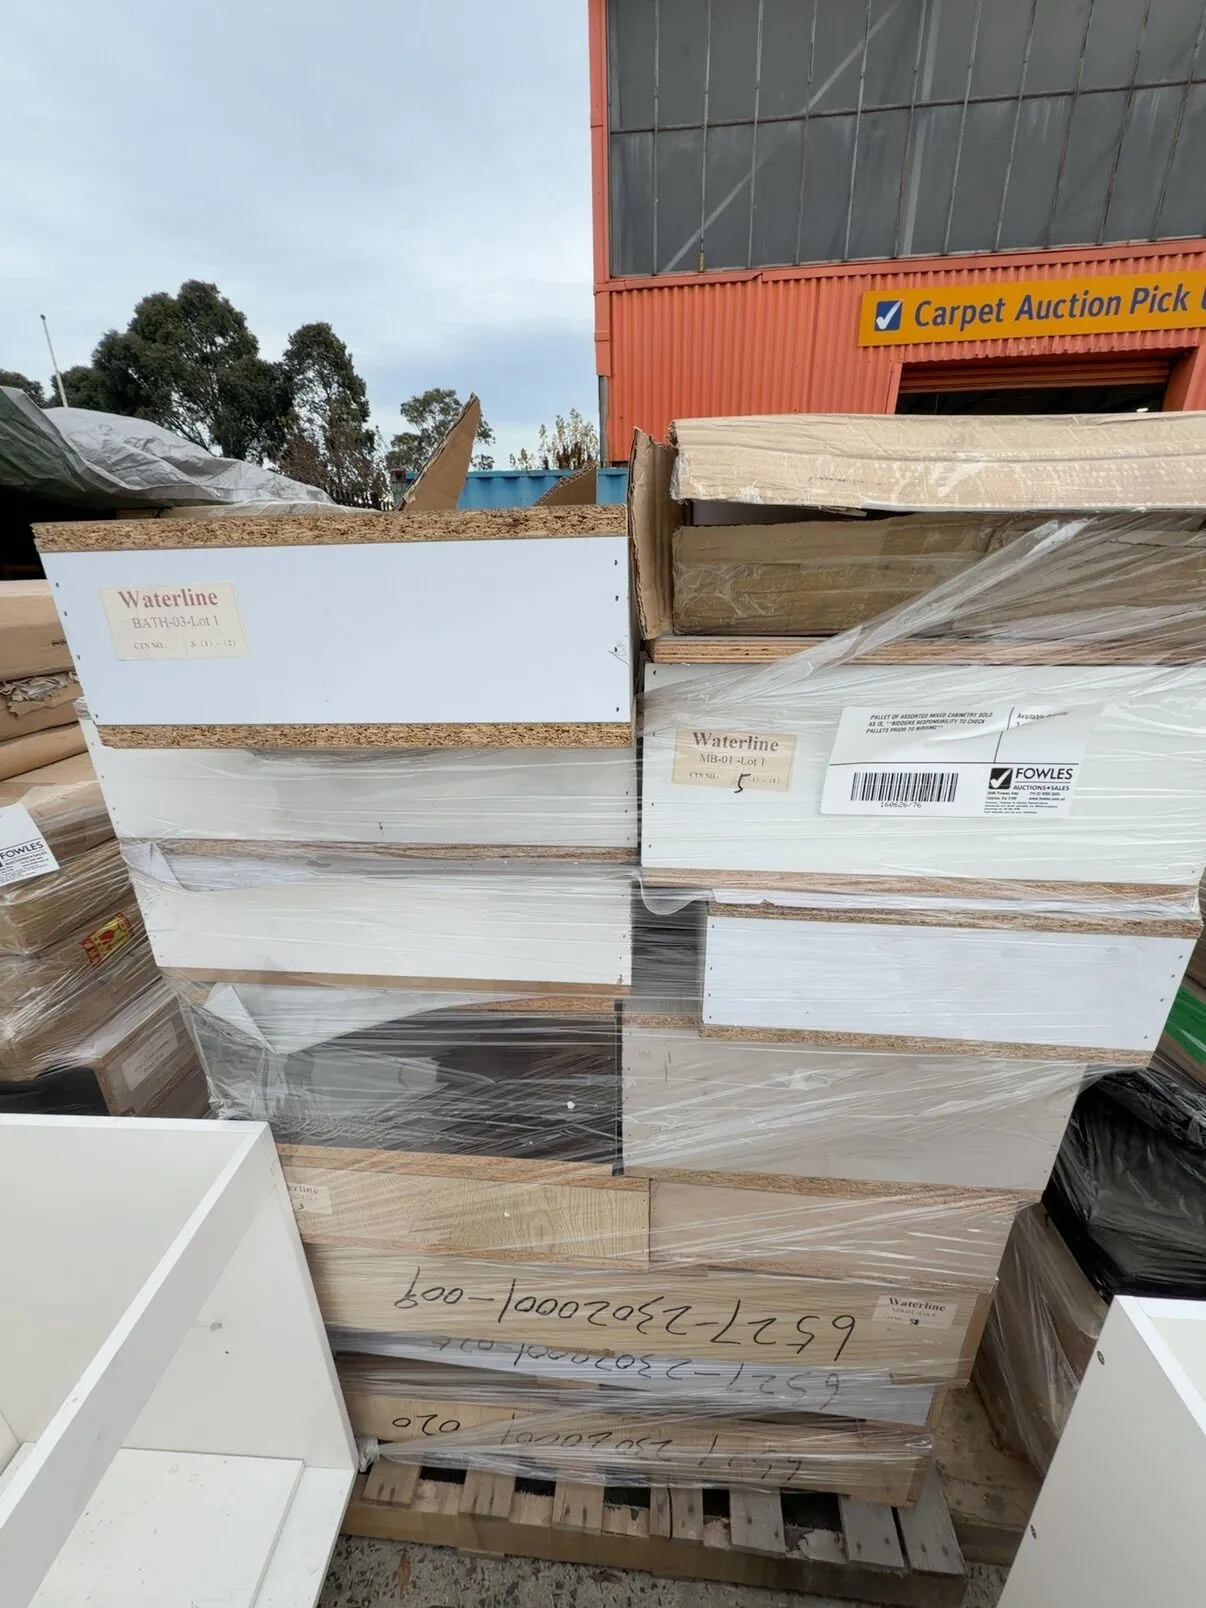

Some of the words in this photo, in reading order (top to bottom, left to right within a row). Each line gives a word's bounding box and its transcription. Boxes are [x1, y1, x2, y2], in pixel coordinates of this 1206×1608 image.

[914, 298, 1006, 332] Carpet
[1014, 290, 1122, 321] Auction
[1129, 283, 1191, 314] Pick
[118, 588, 218, 609] Waterline
[132, 616, 210, 629] BATH-03-Lot
[692, 731, 779, 752] Waterline
[699, 753, 733, 765] MB-01
[1015, 767, 1074, 780] FOWLES
[0, 841, 44, 860] FOWLES
[889, 1297, 946, 1312] Waterline
